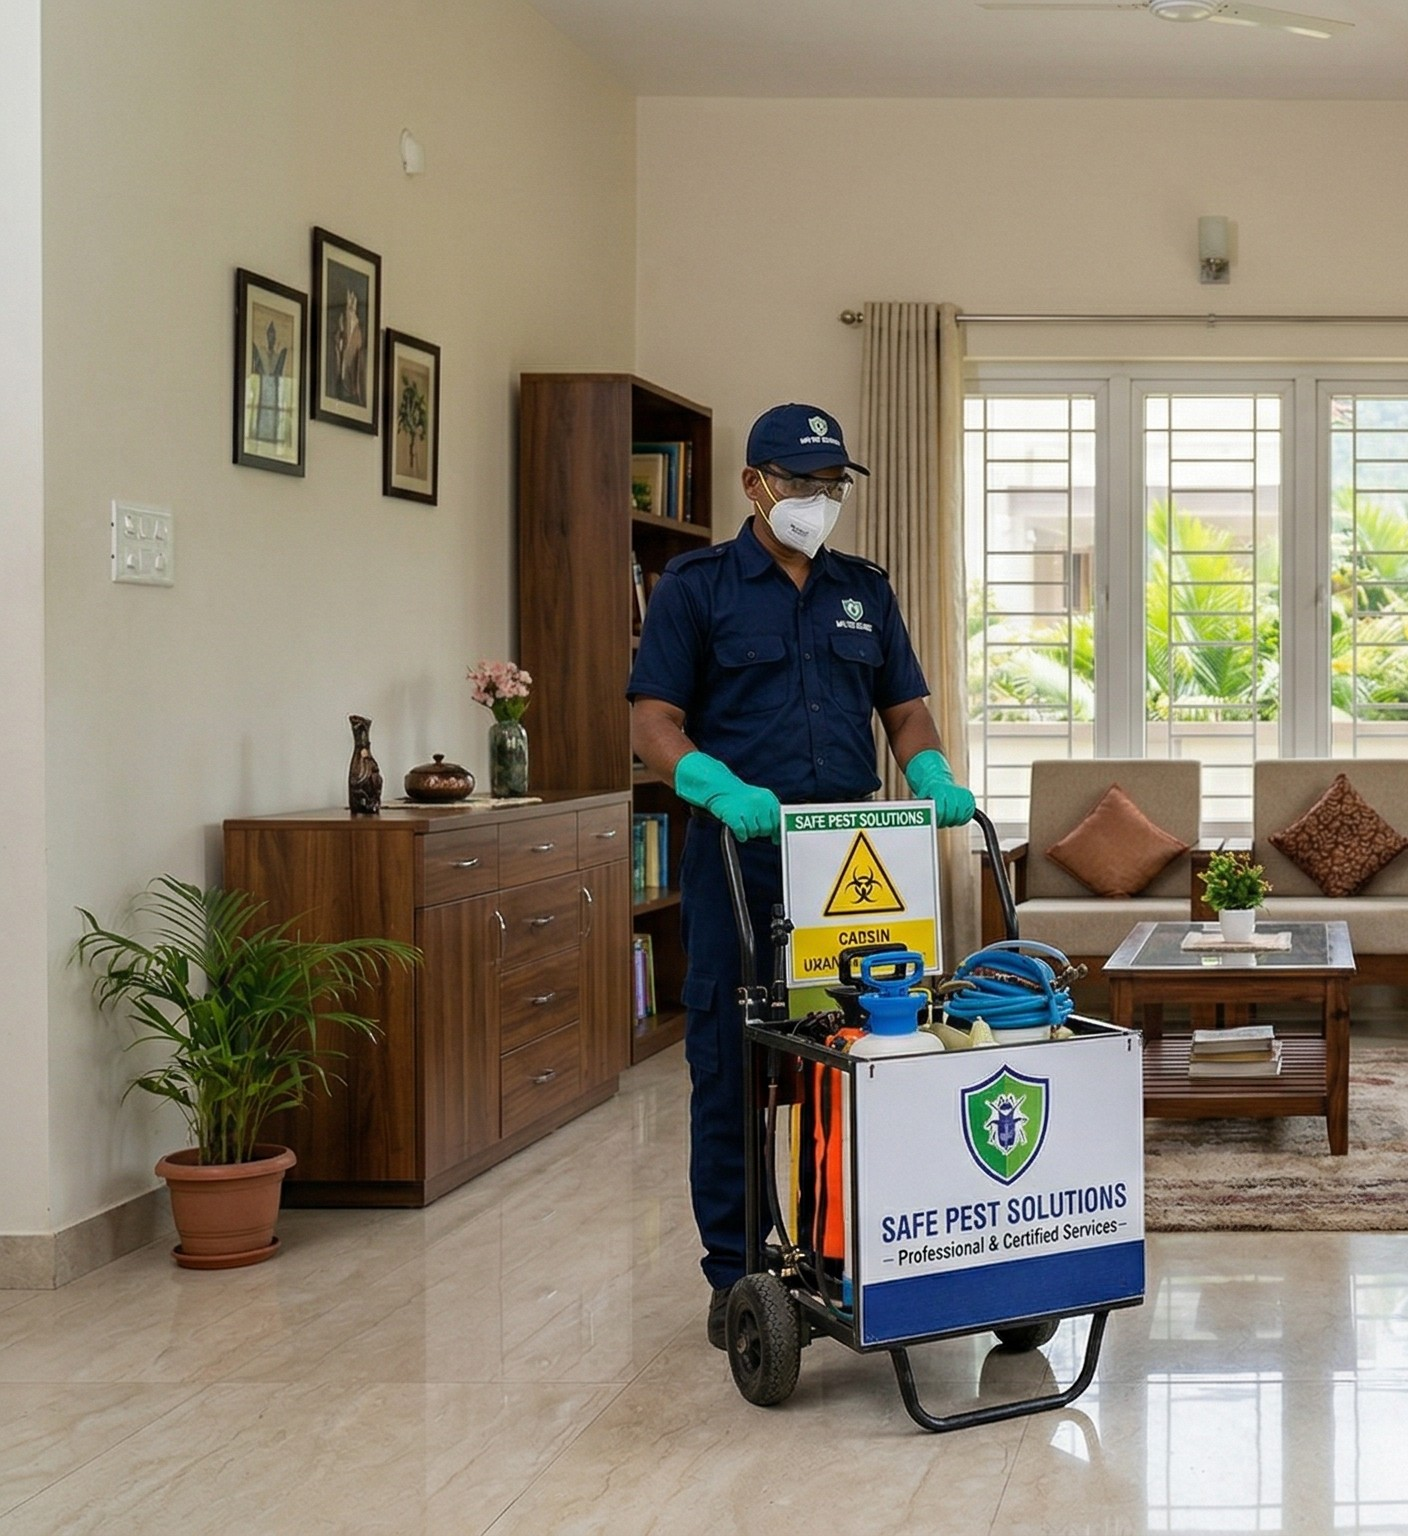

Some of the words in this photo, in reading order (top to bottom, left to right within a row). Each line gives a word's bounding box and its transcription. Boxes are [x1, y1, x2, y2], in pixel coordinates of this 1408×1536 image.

[795, 815, 826, 829] SAFE
[829, 813, 857, 828] PEST
[859, 811, 924, 827] SOLUTIONS
[882, 1210, 938, 1243] SAFE
[946, 1201, 1001, 1234] PEST
[1007, 1183, 1127, 1224] SOLUTIONS
[988, 1235, 999, 1251] &
[1003, 1225, 1059, 1248] Certified
